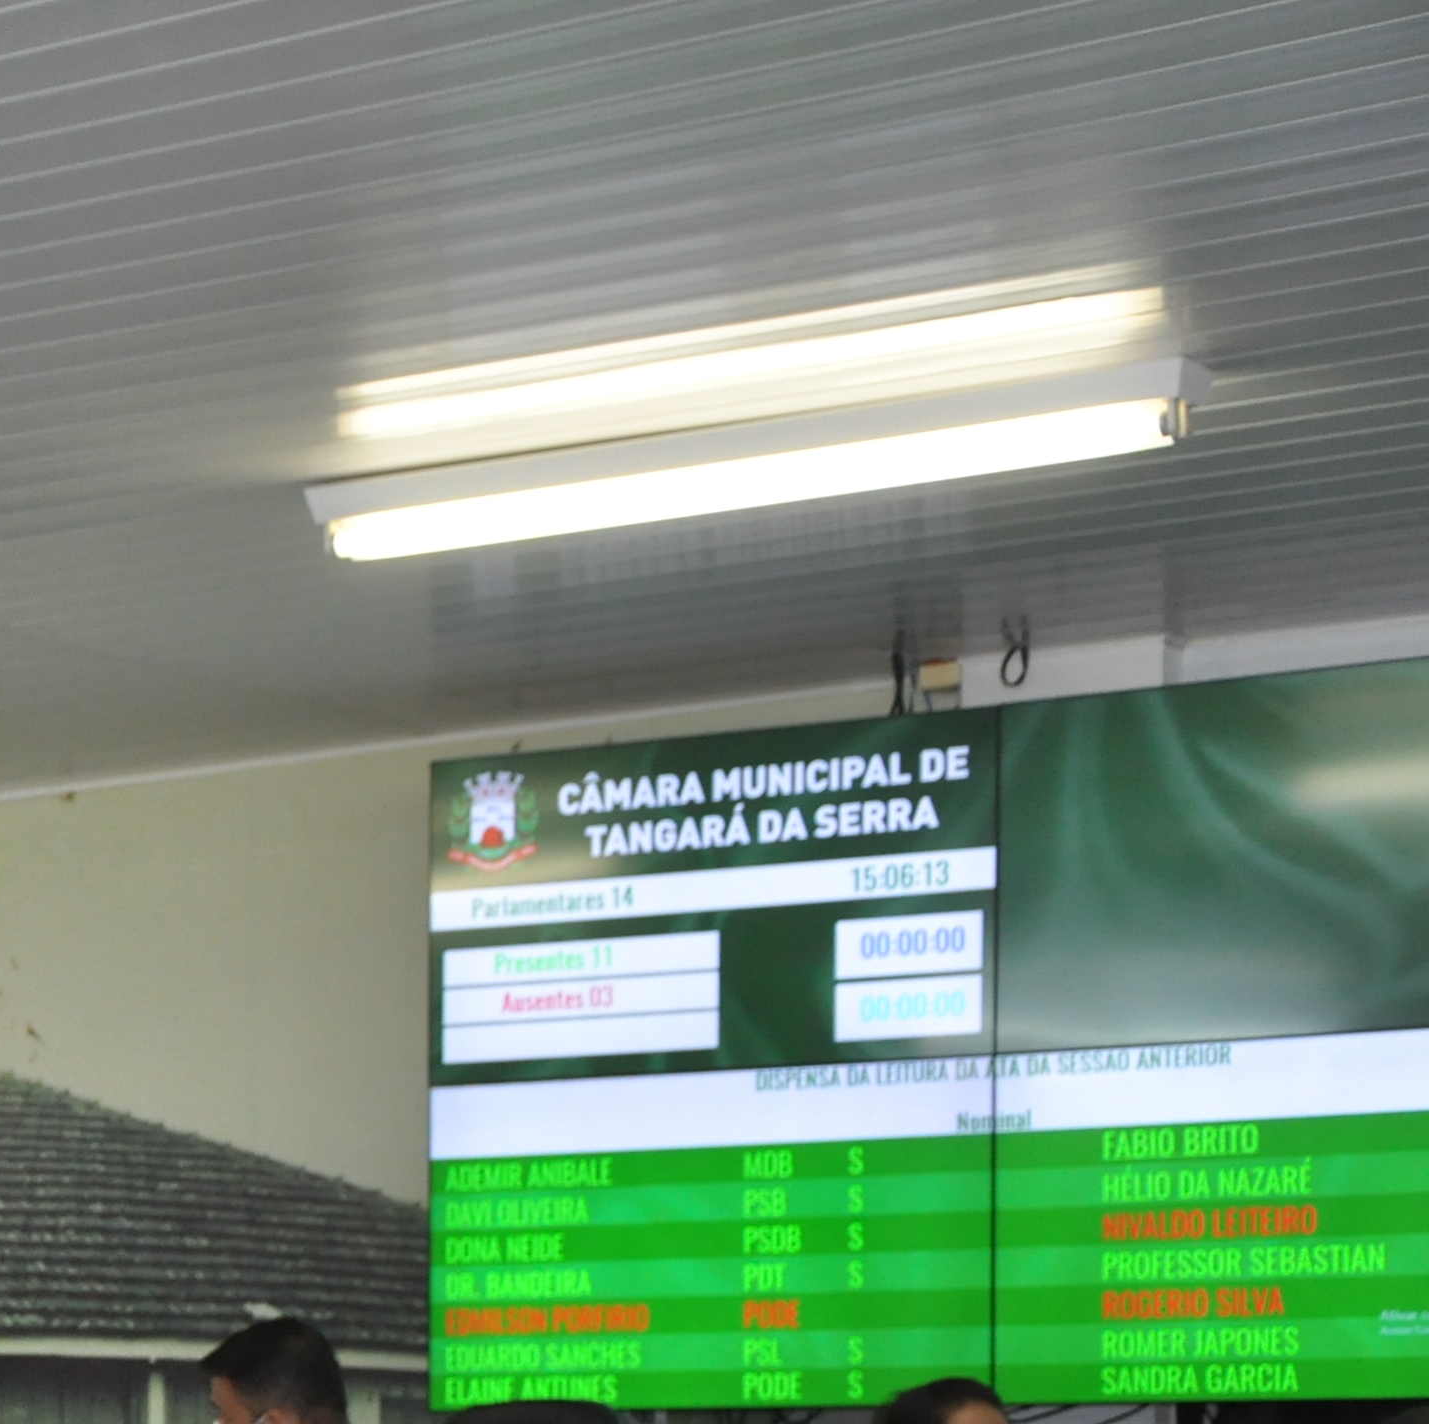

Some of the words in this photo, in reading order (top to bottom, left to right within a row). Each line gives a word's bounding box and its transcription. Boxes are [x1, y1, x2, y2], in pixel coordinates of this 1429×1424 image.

[557, 772, 705, 815] CÂMARA
[712, 752, 910, 802] MUNICIPAL
[919, 745, 969, 782] DE
[586, 803, 750, 857] TANGARÁ
[758, 810, 807, 843] DA
[814, 796, 939, 839] SERRA
[851, 861, 949, 892] 15:06:13
[472, 890, 604, 918] Parlamentares
[613, 887, 634, 908] 14
[860, 926, 966, 959] 00:00:00
[494, 948, 585, 974] Presentes
[592, 946, 614, 968] 11
[502, 987, 584, 1012] Ausentes
[589, 985, 614, 1007] 03
[860, 991, 966, 1022] 00:00:00
[757, 1066, 841, 1091] DISPENSA
[848, 1065, 869, 1086] DA
[877, 1060, 948, 1085] LEITURA
[956, 1058, 978, 1080] DA
[986, 1054, 1020, 1078] ATA
[1027, 1054, 1050, 1076] DA
[1137, 1045, 1231, 1070] ANTERIOR
[957, 1109, 1032, 1132] Nominal
[1102, 1128, 1175, 1161] FABIO
[1183, 1123, 1260, 1157] BRITO
[743, 1149, 793, 1179] MDB
[847, 1145, 864, 1176] S
[445, 1162, 523, 1192] ADEMIR
[1102, 1164, 1172, 1202] HÉLIO
[1178, 1169, 1210, 1200] DA
[1218, 1156, 1313, 1197] NAZARÉ
[743, 1187, 787, 1218] PSB
[847, 1183, 864, 1213] S
[847, 1221, 864, 1251] S
[1102, 1209, 1206, 1240] NIVALDO
[1212, 1204, 1318, 1238] LEITEIRO
[445, 1235, 503, 1265] DONA
[743, 1224, 802, 1255] PSDB
[847, 1259, 864, 1288] S
[1101, 1247, 1242, 1281] PROFESSOR
[1249, 1242, 1386, 1275] SEBASTIAN
[486, 1269, 591, 1300] BANDEIRA
[743, 1263, 788, 1292] PDT
[743, 1299, 800, 1329] PODE
[1102, 1288, 1209, 1320] ROGERIO
[1216, 1286, 1285, 1317] SILVA
[445, 1342, 540, 1371] EDUARDO
[544, 1340, 641, 1370] SANCHES
[743, 1338, 783, 1366] PSL
[847, 1336, 864, 1365] S
[1102, 1328, 1186, 1359] ROMER
[743, 1371, 802, 1400] PODE
[847, 1370, 864, 1399] S
[1101, 1364, 1199, 1395] SANDRA
[1205, 1362, 1299, 1393] GARCIA
